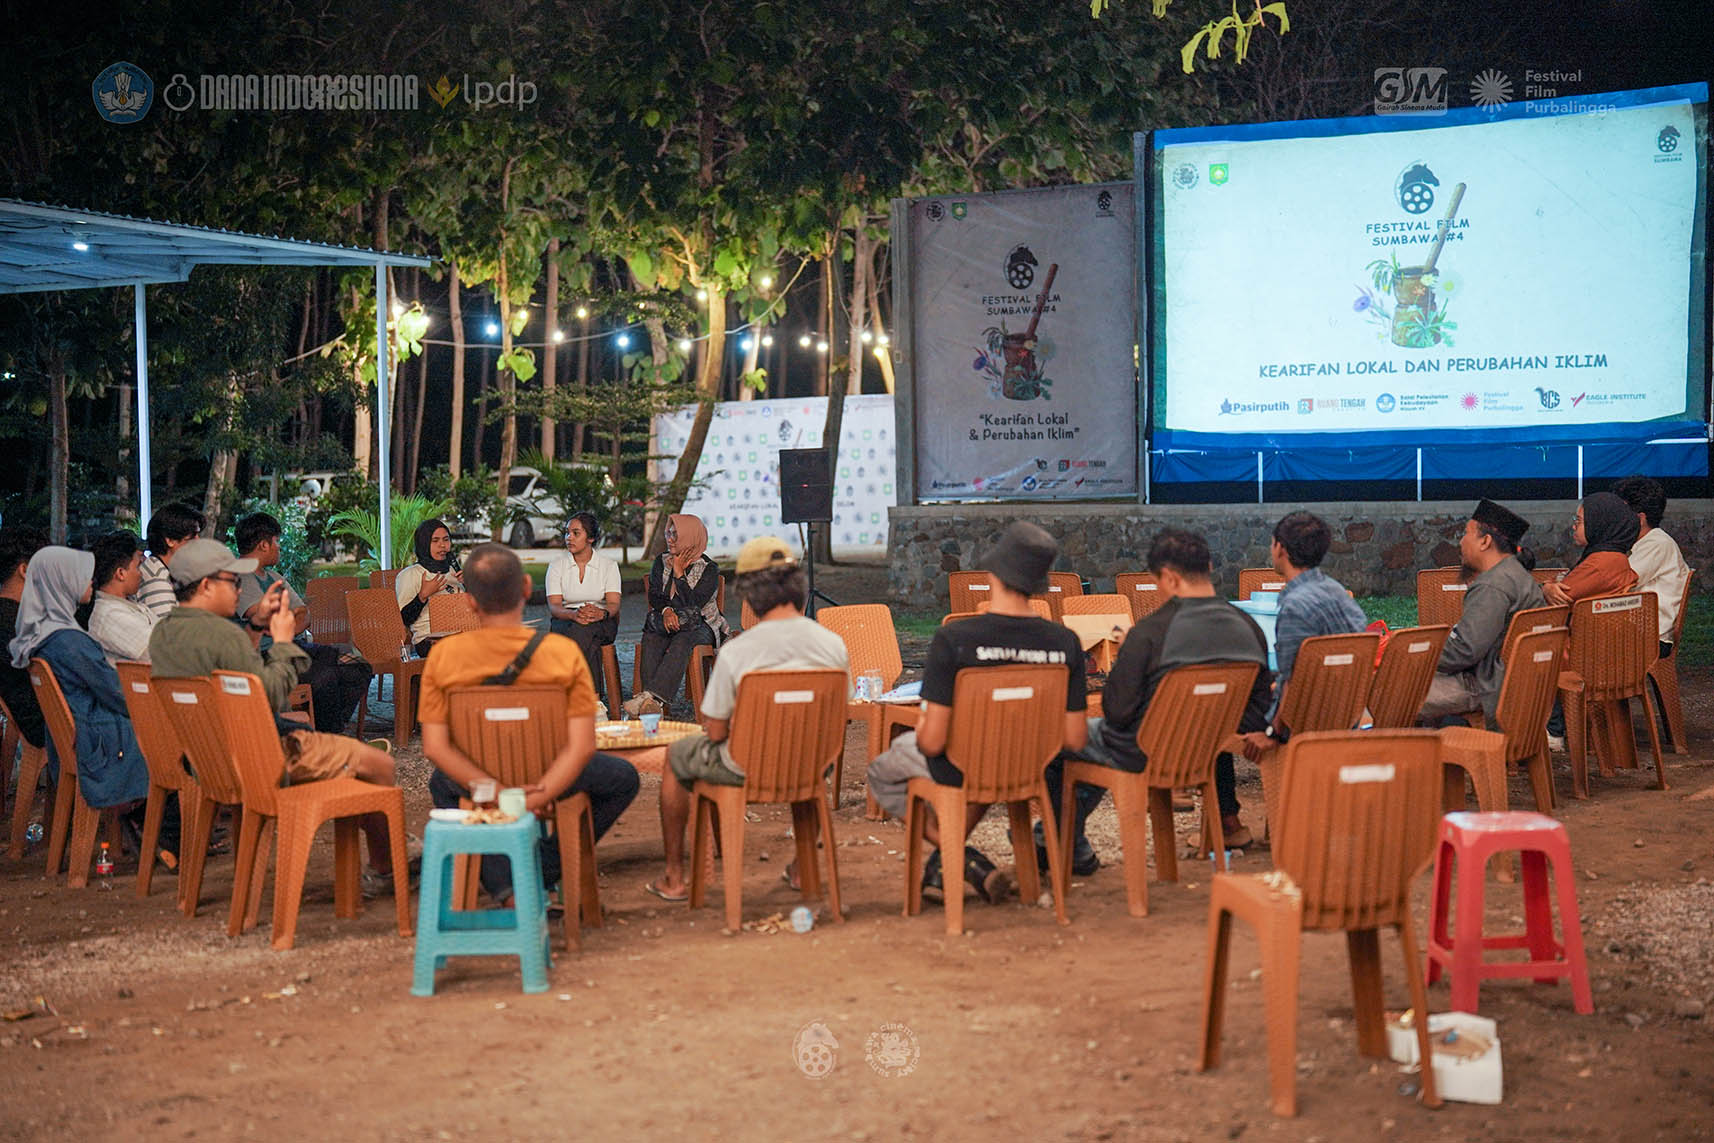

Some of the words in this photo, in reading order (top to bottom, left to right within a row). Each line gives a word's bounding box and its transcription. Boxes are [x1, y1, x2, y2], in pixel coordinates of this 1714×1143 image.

[1366, 221, 1430, 234] FESTIVAL
[1437, 218, 1470, 230] FILM
[1372, 234, 1439, 246] SUMBAWA
[1446, 232, 1464, 242] #4
[982, 295, 1031, 304] FESTIVAL
[987, 305, 1038, 316] SUMBAWA
[1259, 363, 1340, 378] KEARIFAN
[1347, 360, 1398, 375] LOKAL
[1405, 358, 1440, 373] DAN
[1447, 356, 1548, 372] PERUBAHAN
[1555, 354, 1608, 369] IKLIM
[1340, 398, 1366, 408] TENGAH
[1610, 393, 1647, 401] INSTITUTE
[1233, 401, 1290, 413] Pasirputih
[1038, 412, 1069, 425] Lokal
[969, 428, 979, 441] &
[983, 428, 1044, 440] Perubahan
